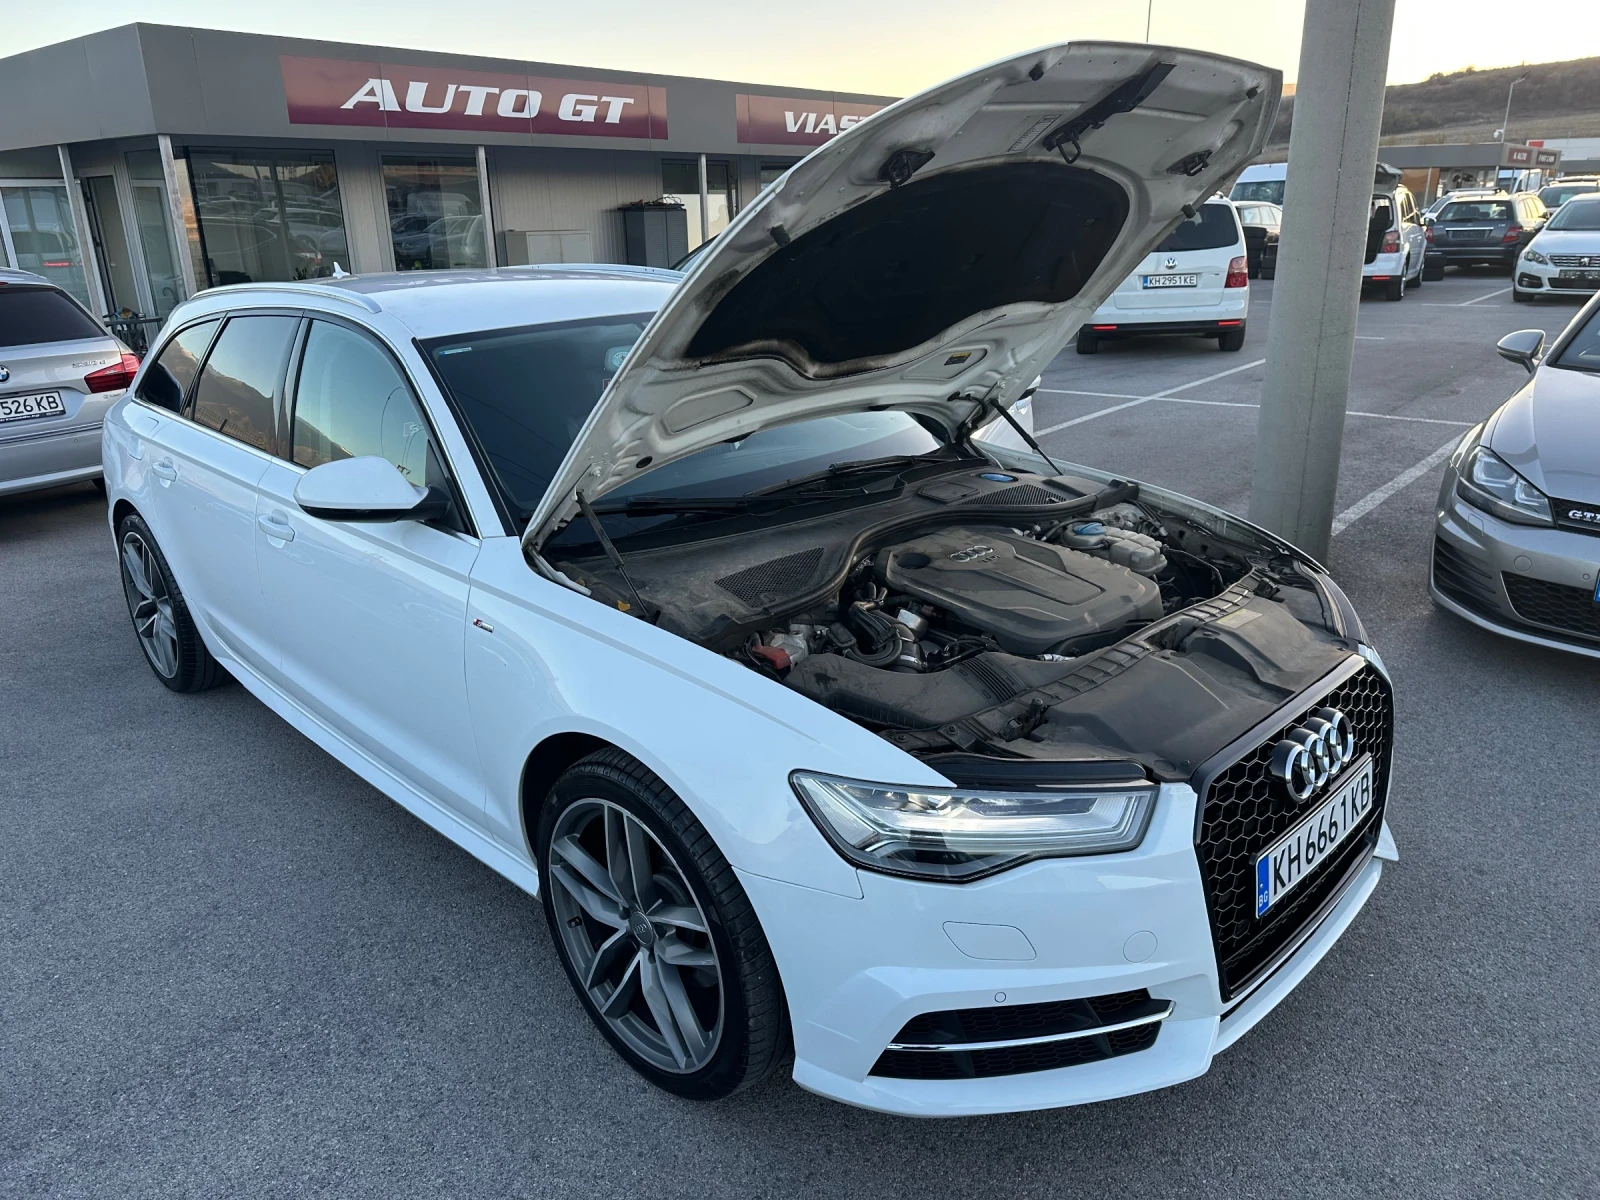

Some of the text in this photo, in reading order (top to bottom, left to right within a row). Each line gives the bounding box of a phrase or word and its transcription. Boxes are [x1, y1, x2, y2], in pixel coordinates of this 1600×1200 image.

[340, 78, 635, 124] AUTO GT
[784, 110, 868, 135] VIAS
[1258, 890, 1269, 907] BG
